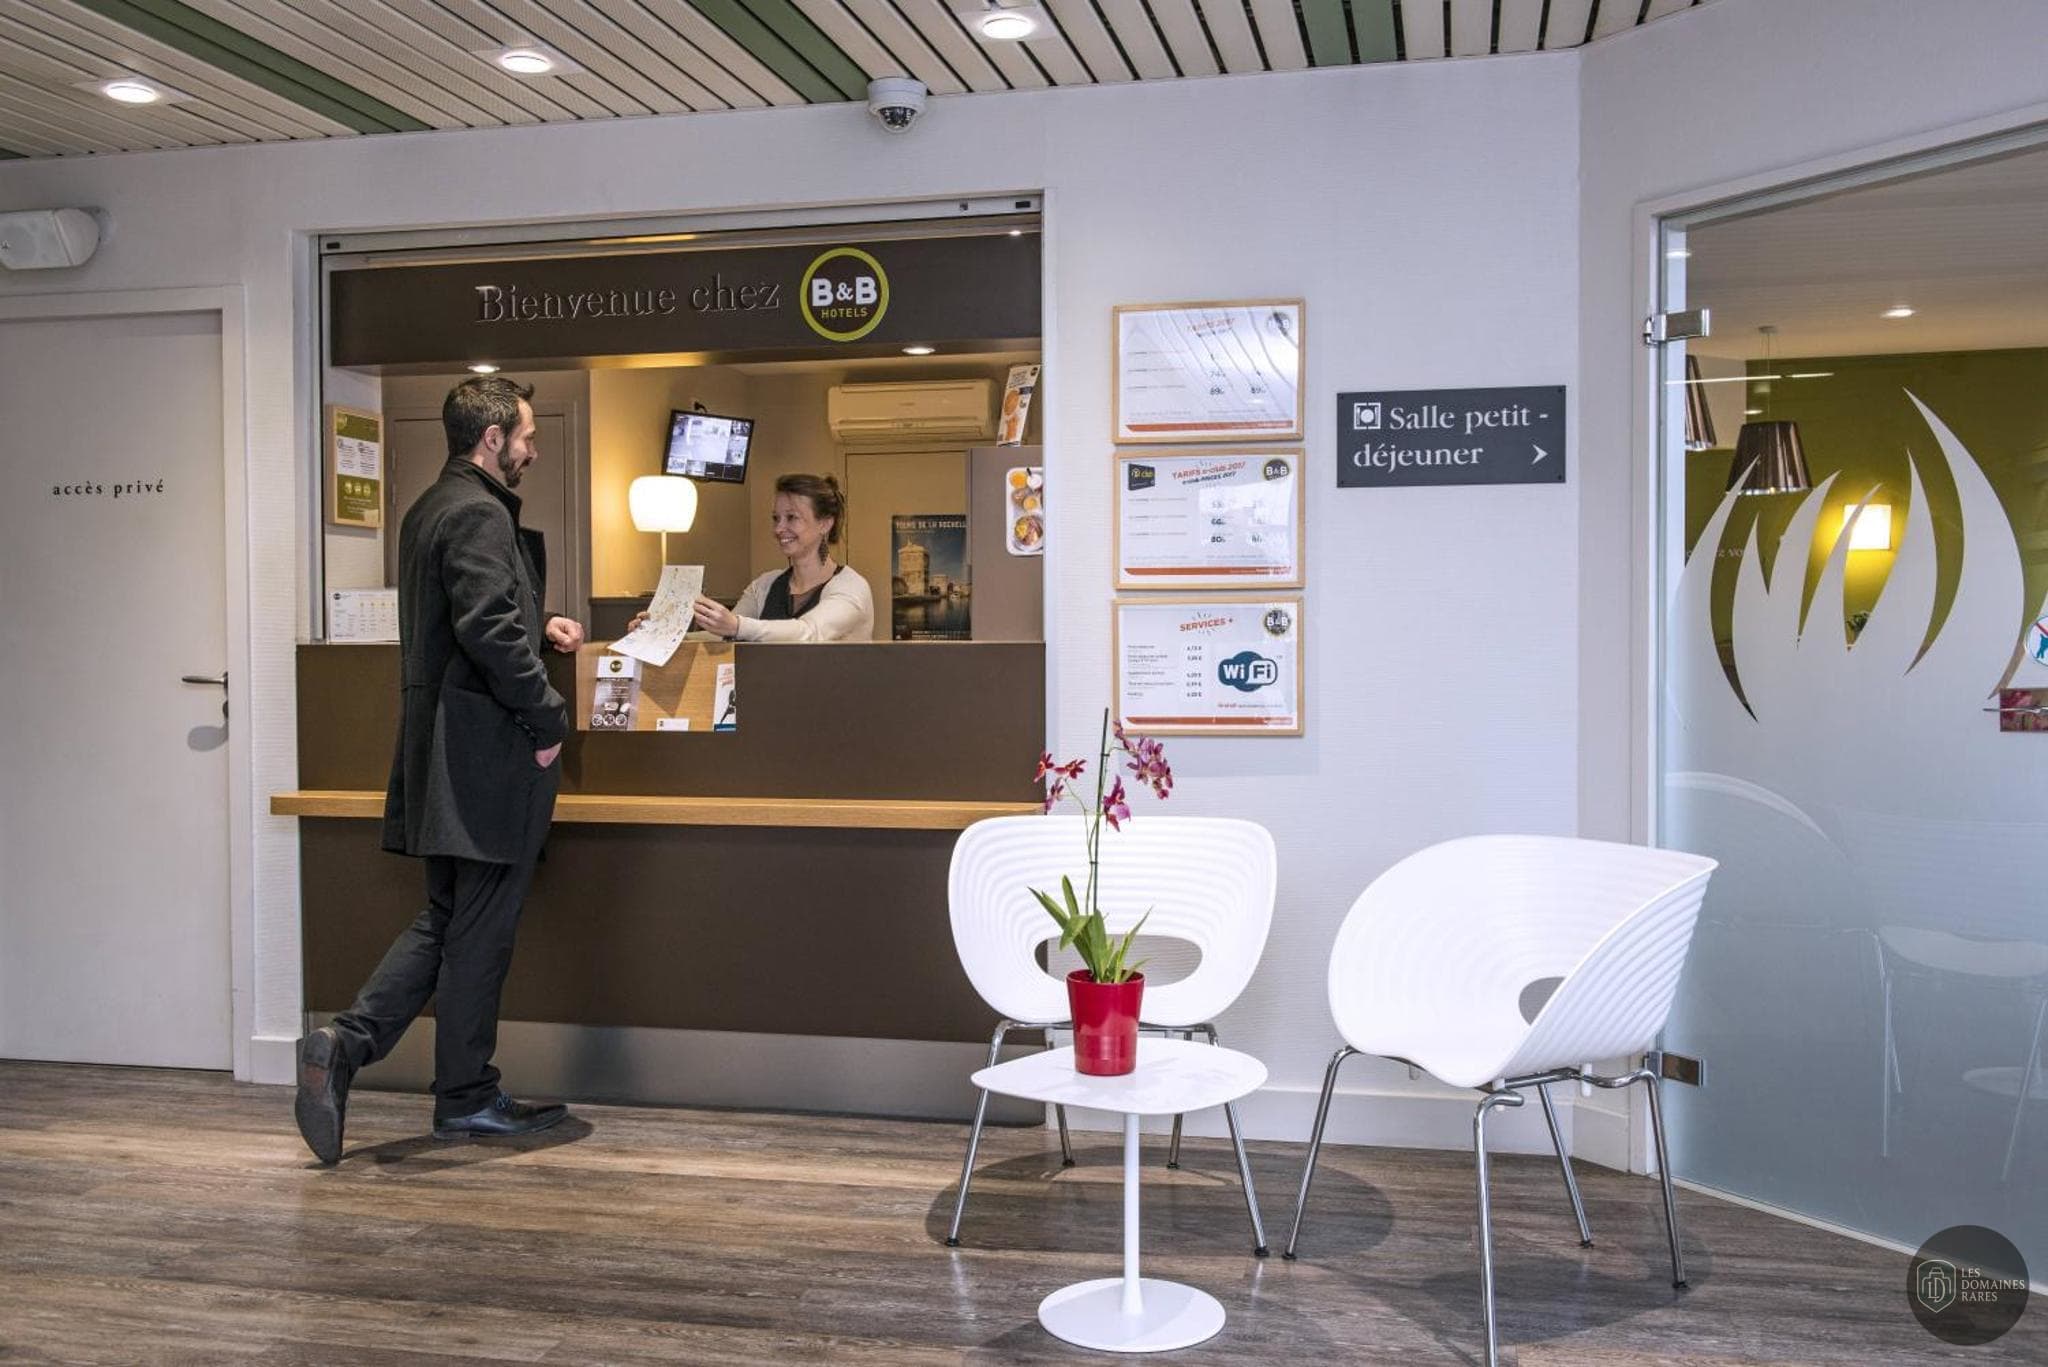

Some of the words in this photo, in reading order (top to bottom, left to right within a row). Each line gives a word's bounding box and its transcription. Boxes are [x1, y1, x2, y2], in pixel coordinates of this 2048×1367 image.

[473, 283, 676, 323] Bienvenue
[691, 272, 780, 312] chez
[811, 276, 878, 307] B&B
[821, 307, 868, 318] HOTELS
[1389, 404, 1455, 431] Salle
[1464, 404, 1531, 434] petit
[1353, 442, 1484, 473] déjeuner
[52, 481, 103, 496] accès
[113, 479, 164, 498] privé
[1179, 617, 1226, 632] SERVICES
